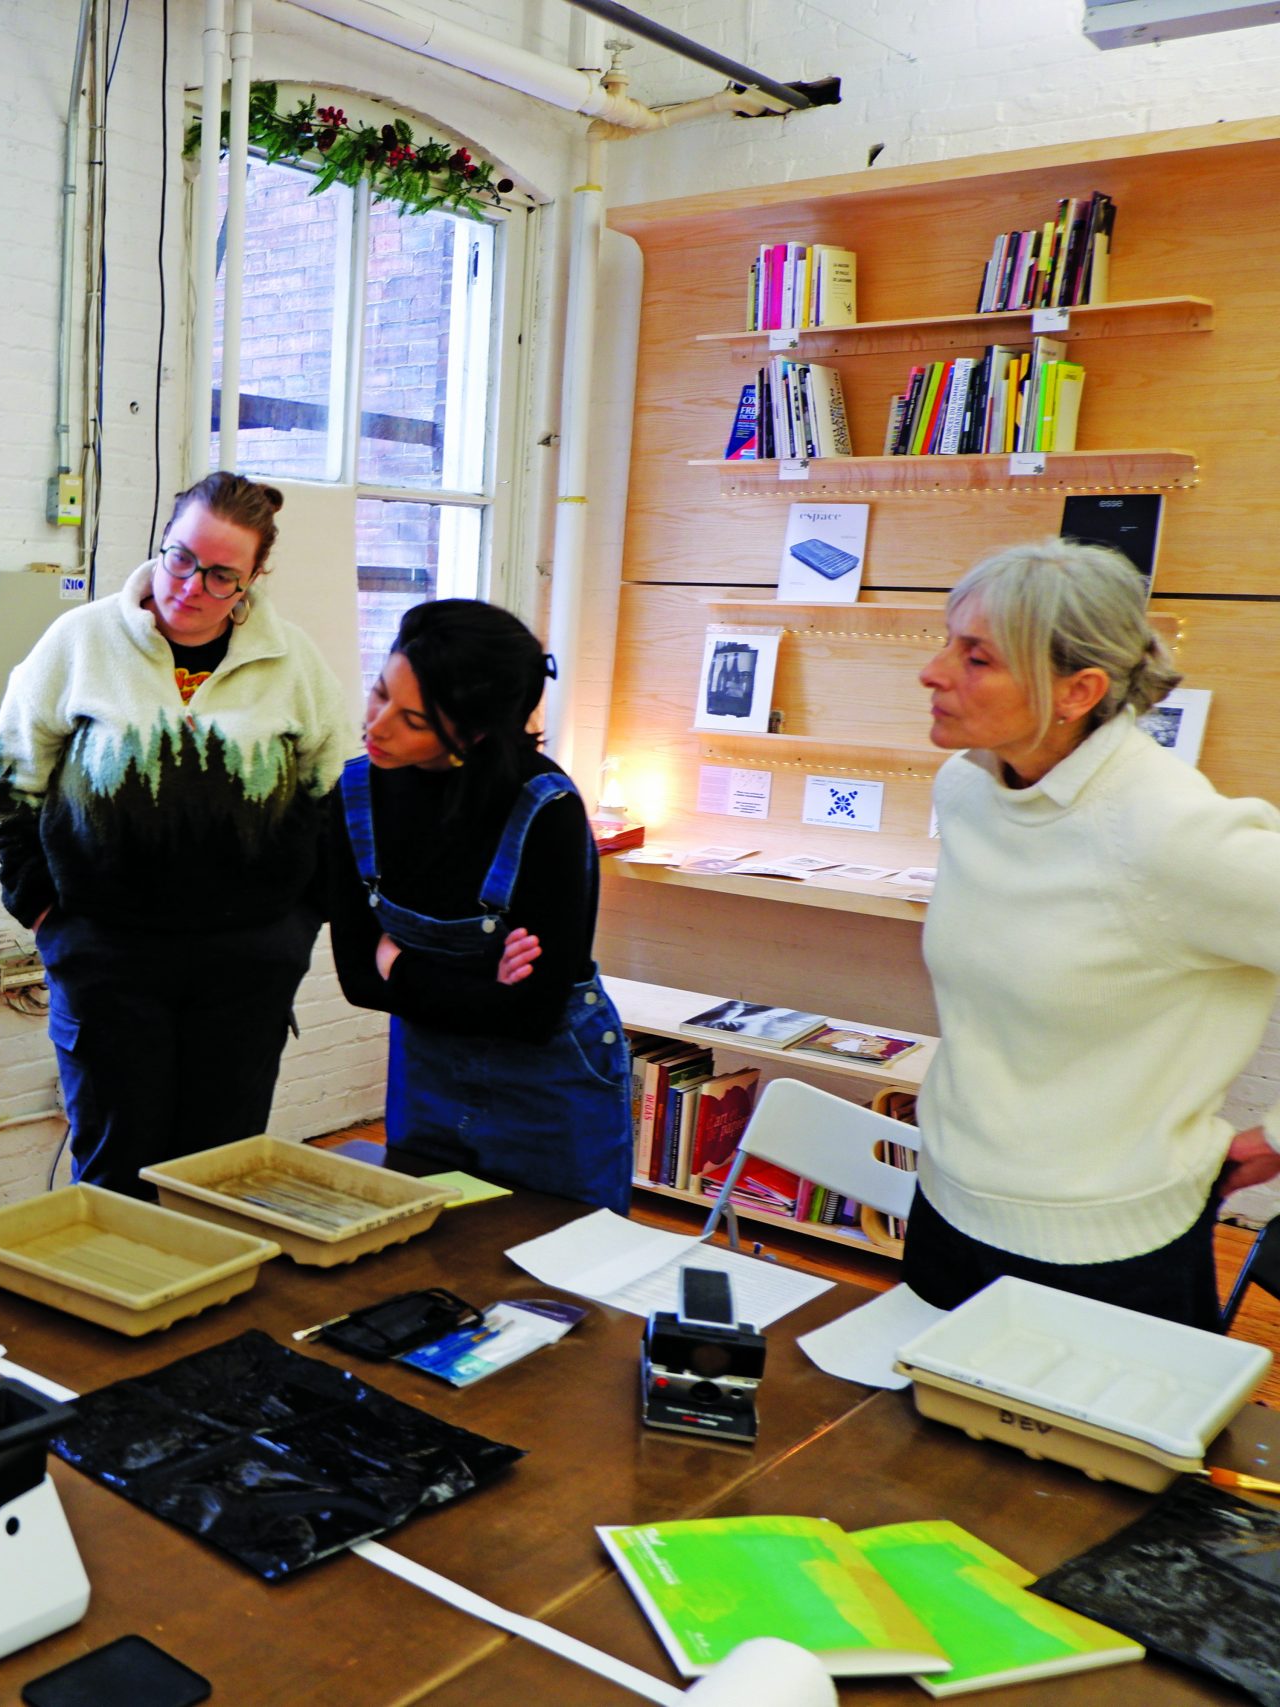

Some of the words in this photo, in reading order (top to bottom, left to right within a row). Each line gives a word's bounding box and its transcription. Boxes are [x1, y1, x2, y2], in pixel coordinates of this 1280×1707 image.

[799, 512, 842, 522] espace
[644, 1094, 655, 1121] DEGAS
[1000, 1409, 1053, 1434] DEV
